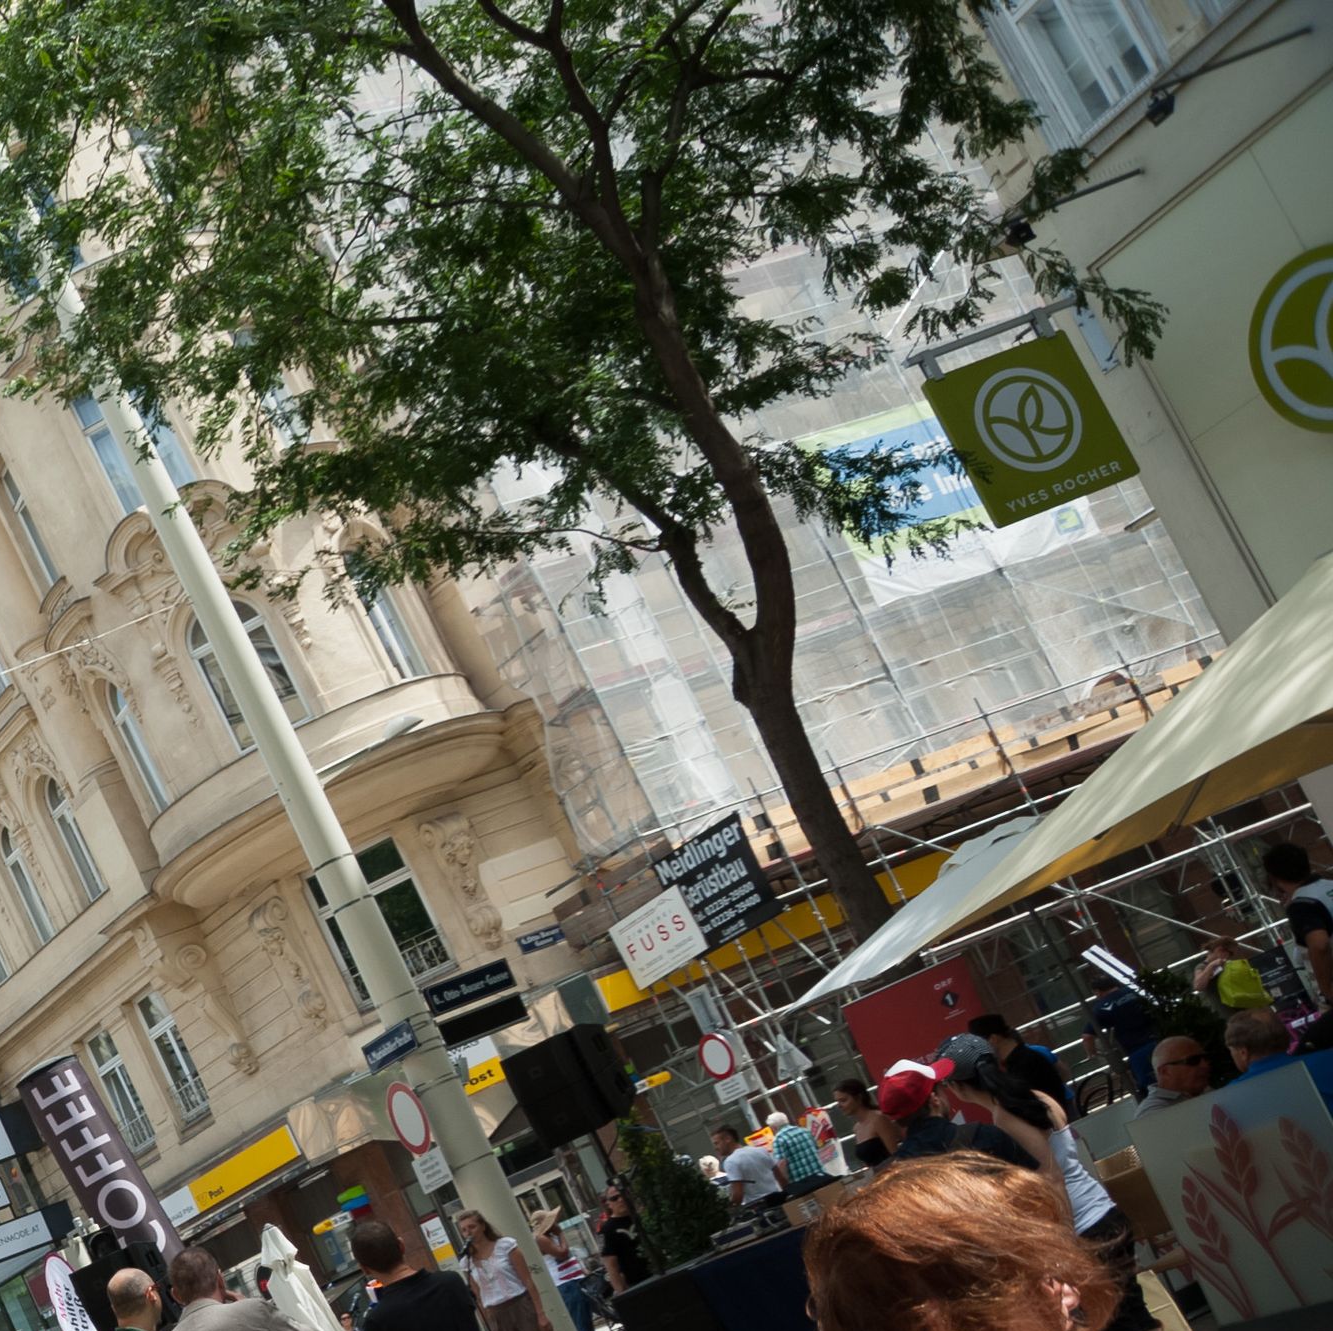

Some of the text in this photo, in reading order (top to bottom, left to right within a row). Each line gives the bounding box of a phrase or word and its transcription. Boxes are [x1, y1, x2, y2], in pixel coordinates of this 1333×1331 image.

[1005, 487, 1048, 514] YVES
[1051, 460, 1123, 496] ROCHER
[654, 821, 742, 886] Meidlinger
[626, 914, 686, 961] FUSS
[933, 977, 954, 991] ORF
[208, 1185, 226, 1200] Post
